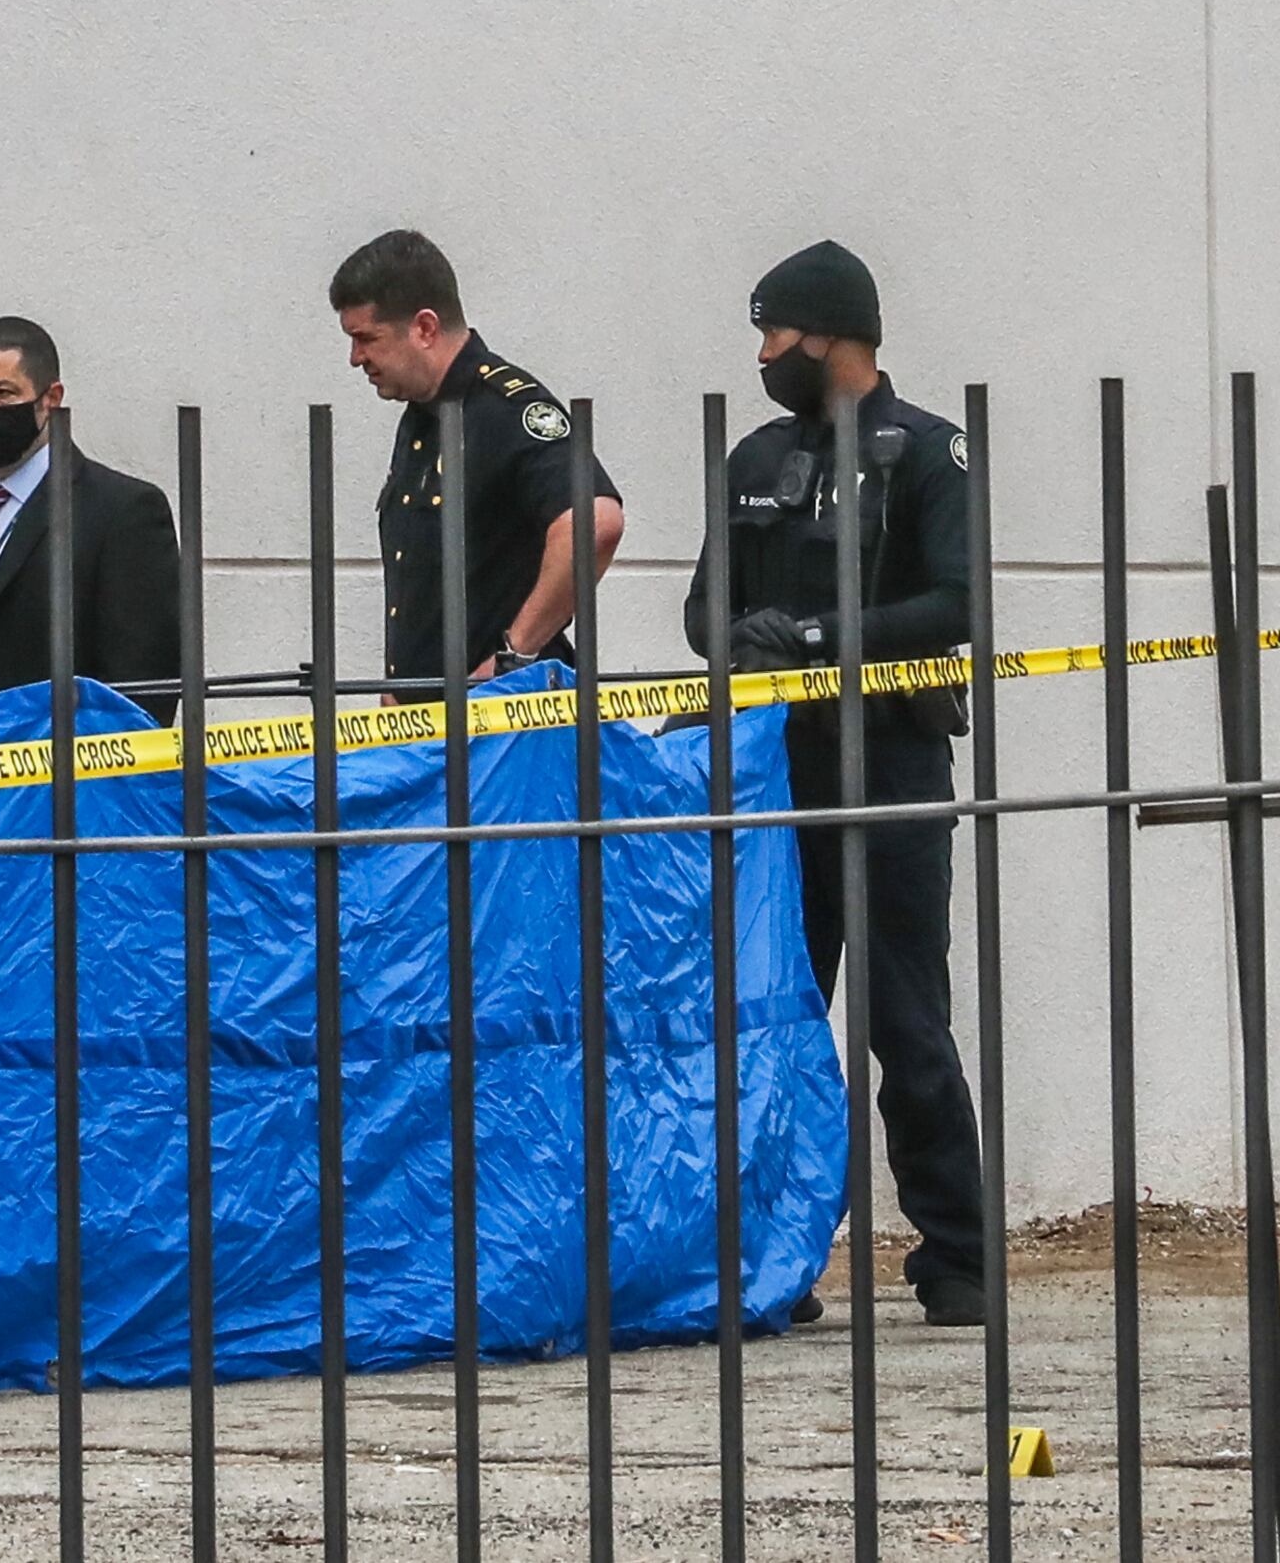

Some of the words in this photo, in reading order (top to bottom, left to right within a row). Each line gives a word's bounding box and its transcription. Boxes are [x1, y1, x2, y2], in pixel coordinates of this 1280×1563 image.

[802, 669, 841, 700] POLI
[864, 663, 902, 693] LINE
[904, 659, 933, 688] DO
[934, 656, 968, 685] NOT
[993, 652, 1029, 679] OSS
[504, 696, 568, 729] POLICE
[567, 691, 609, 722] LE
[609, 689, 636, 718] DO
[637, 686, 671, 716] NOT
[674, 681, 710, 712] CRO
[10, 747, 38, 776] DO
[77, 737, 136, 772] CROSS
[206, 725, 269, 759] POLICE
[269, 721, 310, 753] LINE
[338, 714, 371, 745] NOT
[376, 708, 436, 741] CROSS
